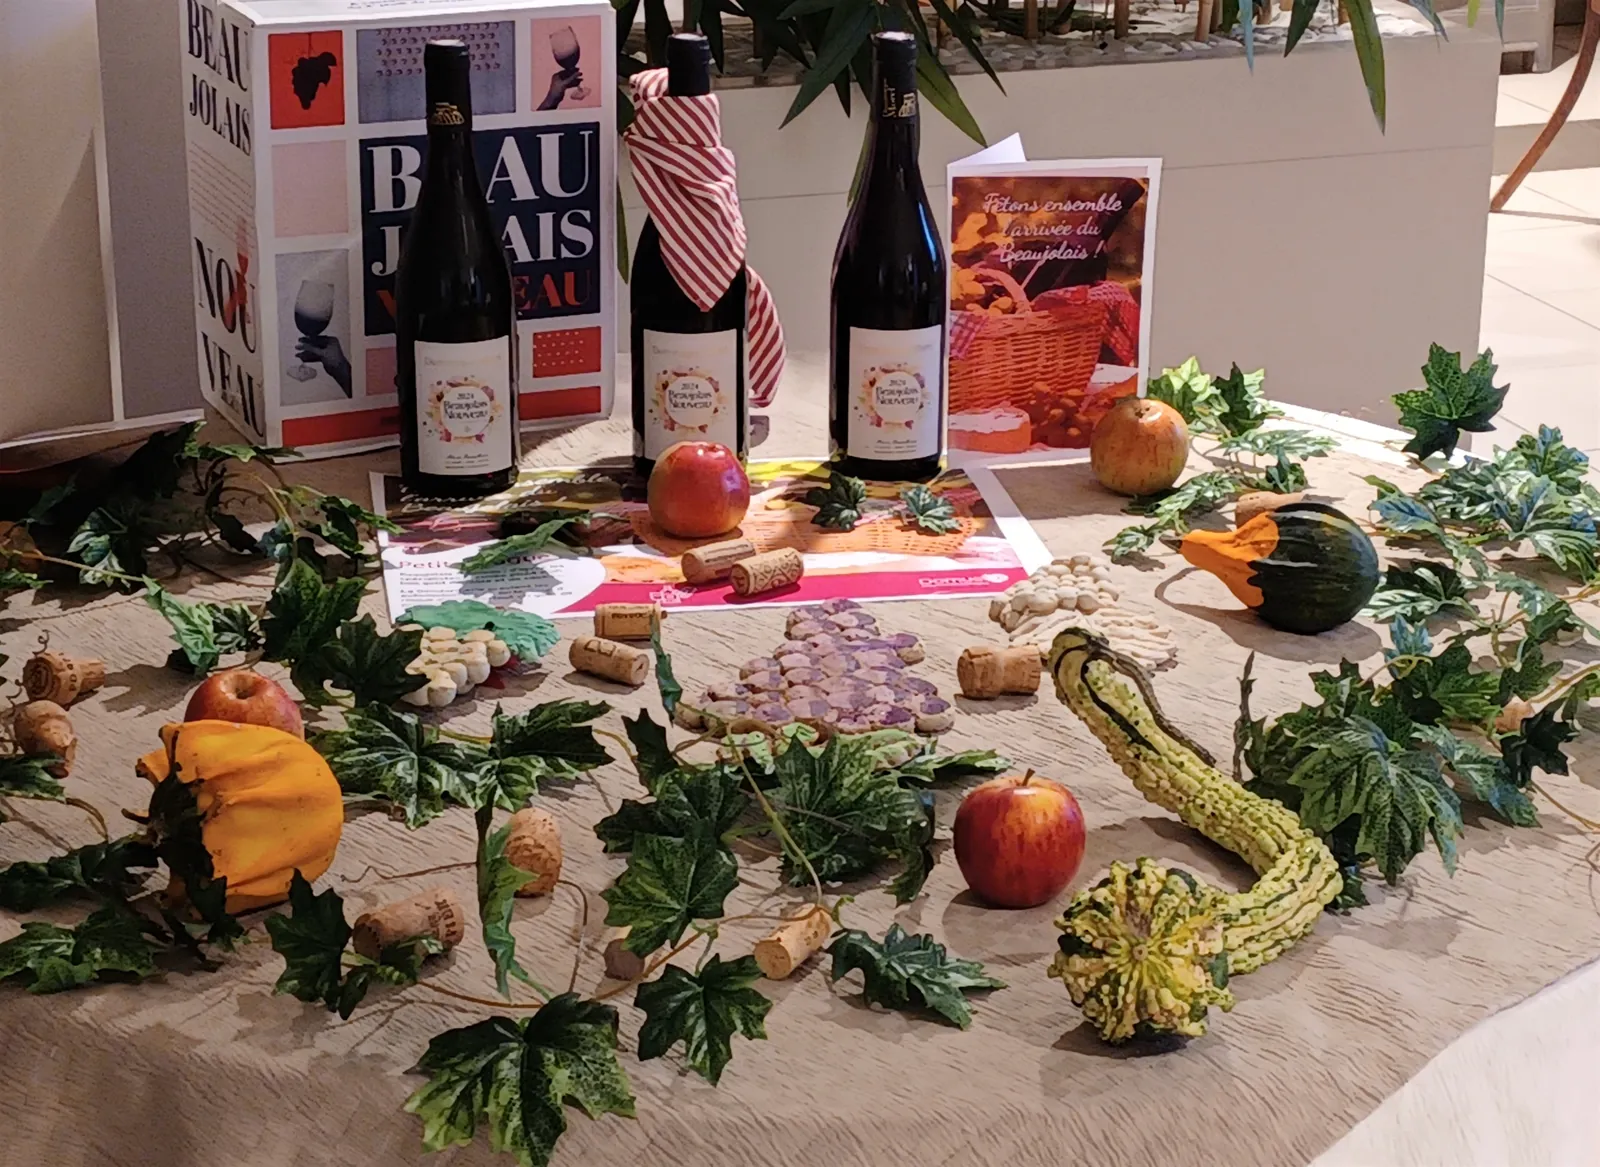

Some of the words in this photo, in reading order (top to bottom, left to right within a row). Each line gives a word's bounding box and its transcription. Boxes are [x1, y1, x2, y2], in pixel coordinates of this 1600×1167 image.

[187, 0, 248, 92] BEAU
[189, 72, 252, 157] JOLAIS
[366, 130, 594, 214] BAU
[982, 192, 1039, 213] Fêtons
[1043, 192, 1123, 212] ensemble
[371, 208, 594, 277] JAIS
[999, 240, 1089, 268] Beaujolais
[1076, 215, 1101, 236] du
[194, 236, 257, 354] NOU
[201, 331, 264, 438] VEAU
